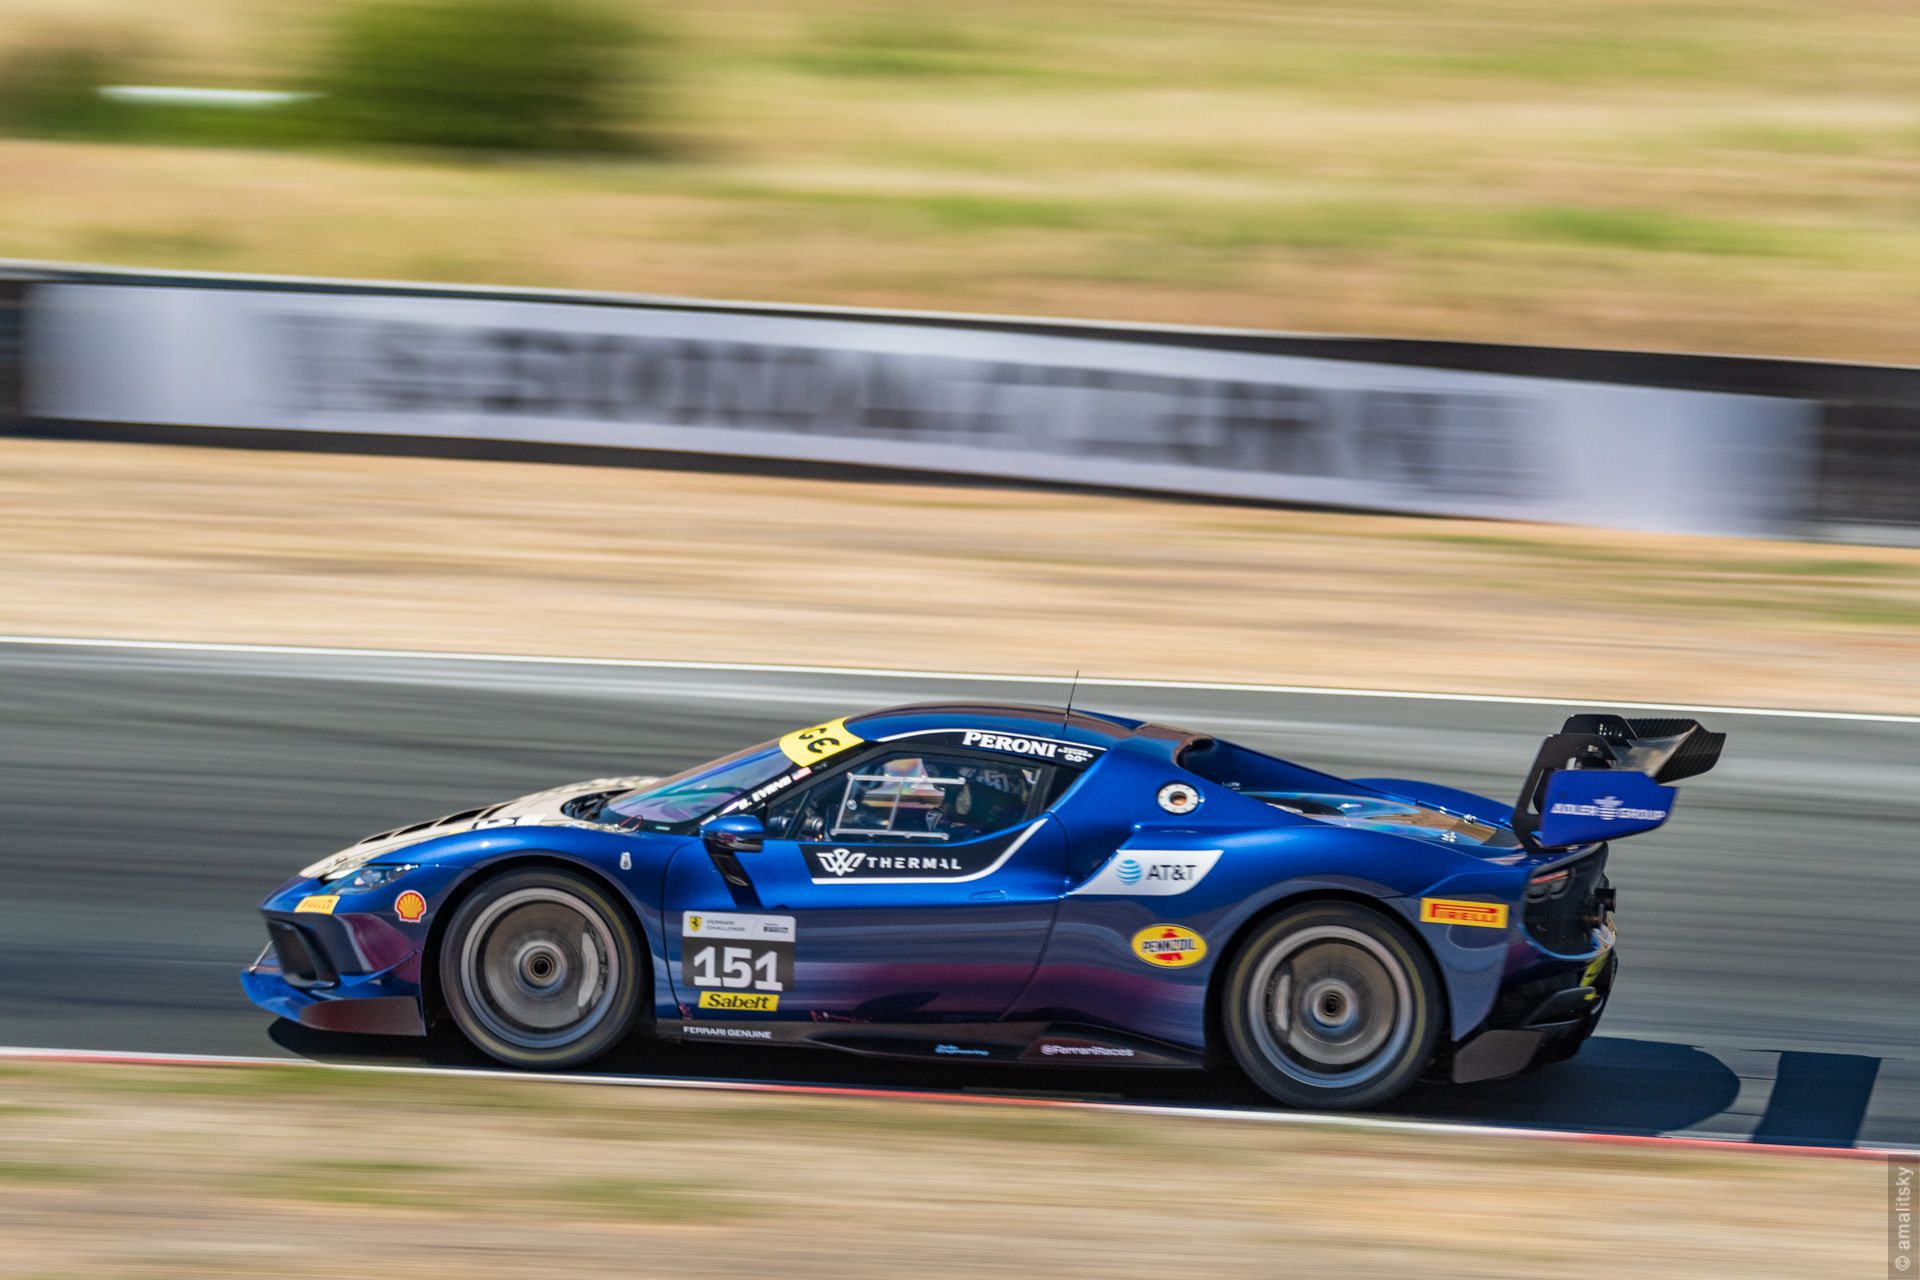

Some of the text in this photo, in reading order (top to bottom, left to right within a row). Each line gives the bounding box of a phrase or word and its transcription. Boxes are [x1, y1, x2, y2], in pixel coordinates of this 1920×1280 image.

[962, 732, 1058, 757] PERONI
[752, 775, 793, 803] EVANS
[866, 857, 962, 870] THERMAL
[1146, 864, 1197, 881] AT&T
[301, 898, 334, 910] PIRELLI
[1431, 903, 1498, 923] PIRELLI
[1142, 938, 1197, 953] PENNZOIL
[693, 946, 783, 991] 151
[707, 993, 771, 1010] Sabelt
[683, 1026, 772, 1039] FERRARI GENUINE
